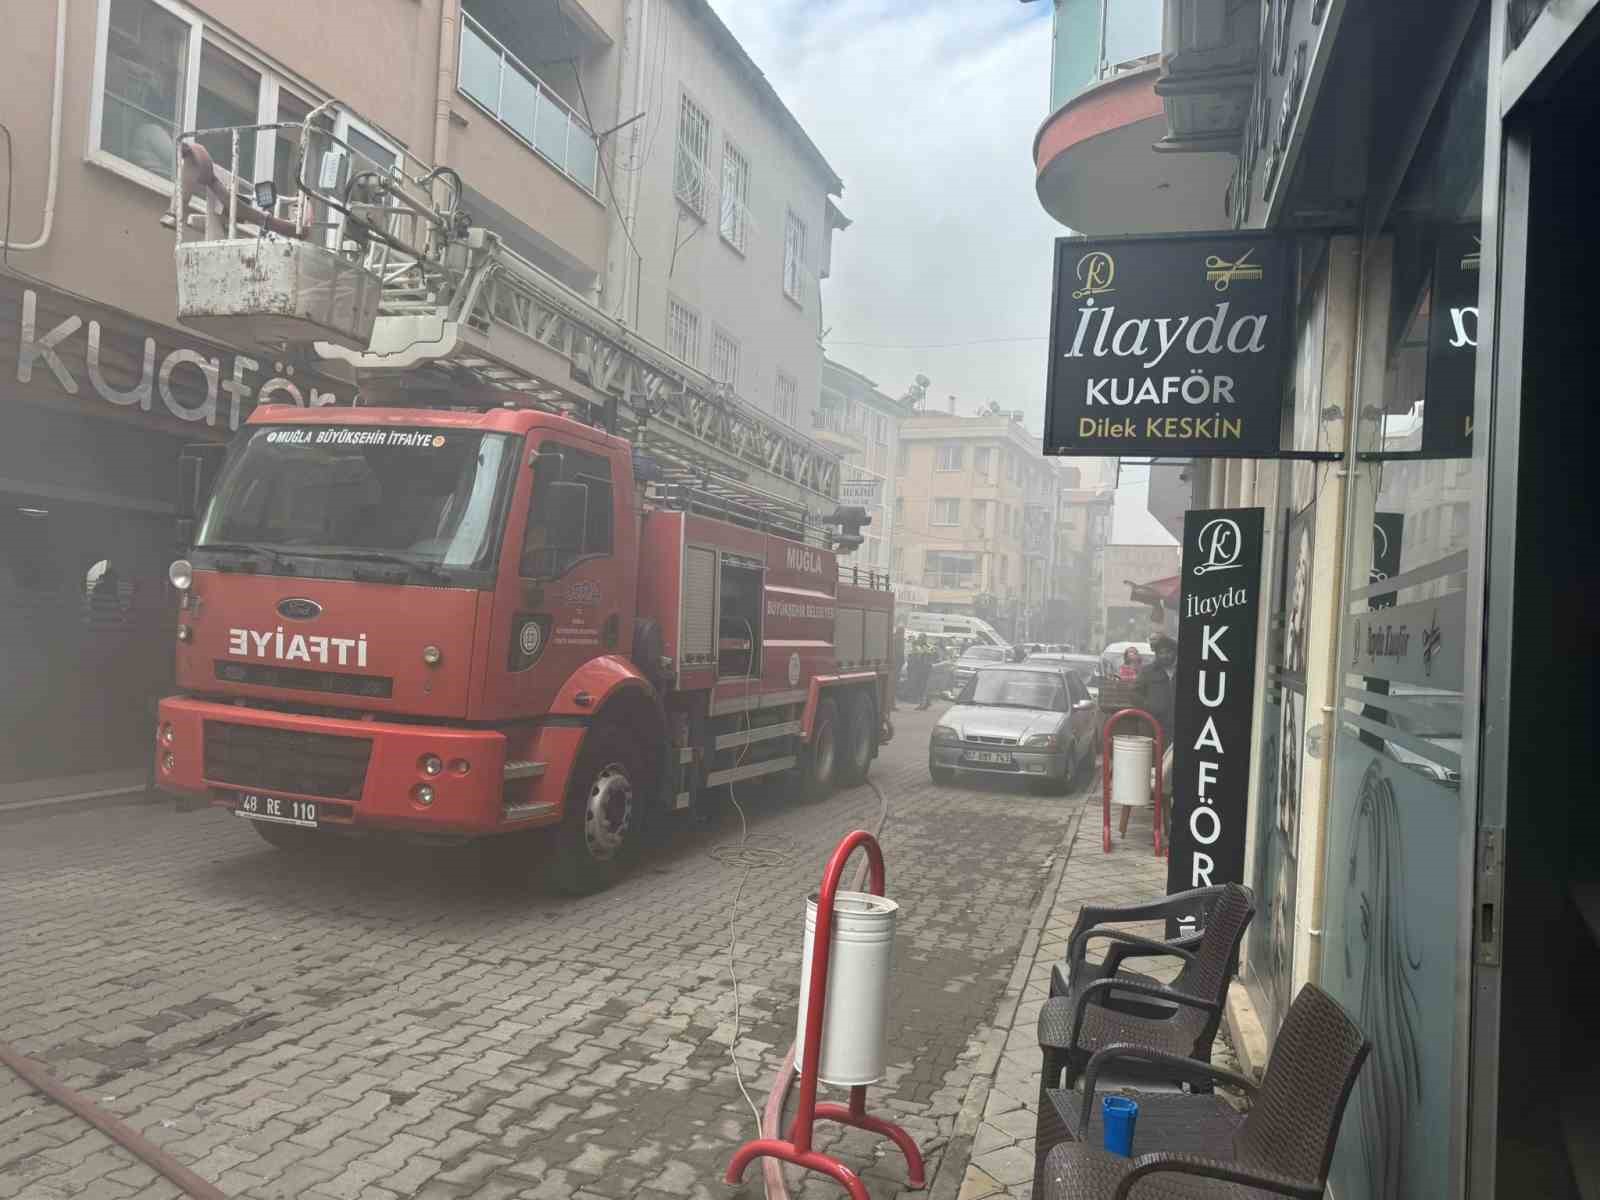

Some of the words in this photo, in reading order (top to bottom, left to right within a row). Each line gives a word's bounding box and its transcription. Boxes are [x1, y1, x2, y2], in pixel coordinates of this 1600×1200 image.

[1063, 297, 1268, 369] İlayda
[1085, 368, 1235, 406] KUAFÖR
[1079, 417, 1137, 437] Dilek
[1146, 412, 1242, 439] KESKİN
[1186, 586, 1247, 618] İlayda
[1189, 625, 1231, 888] KUAFÖR
[243, 795, 258, 812] 48
[266, 798, 281, 815] RE
[292, 802, 316, 820] 110
